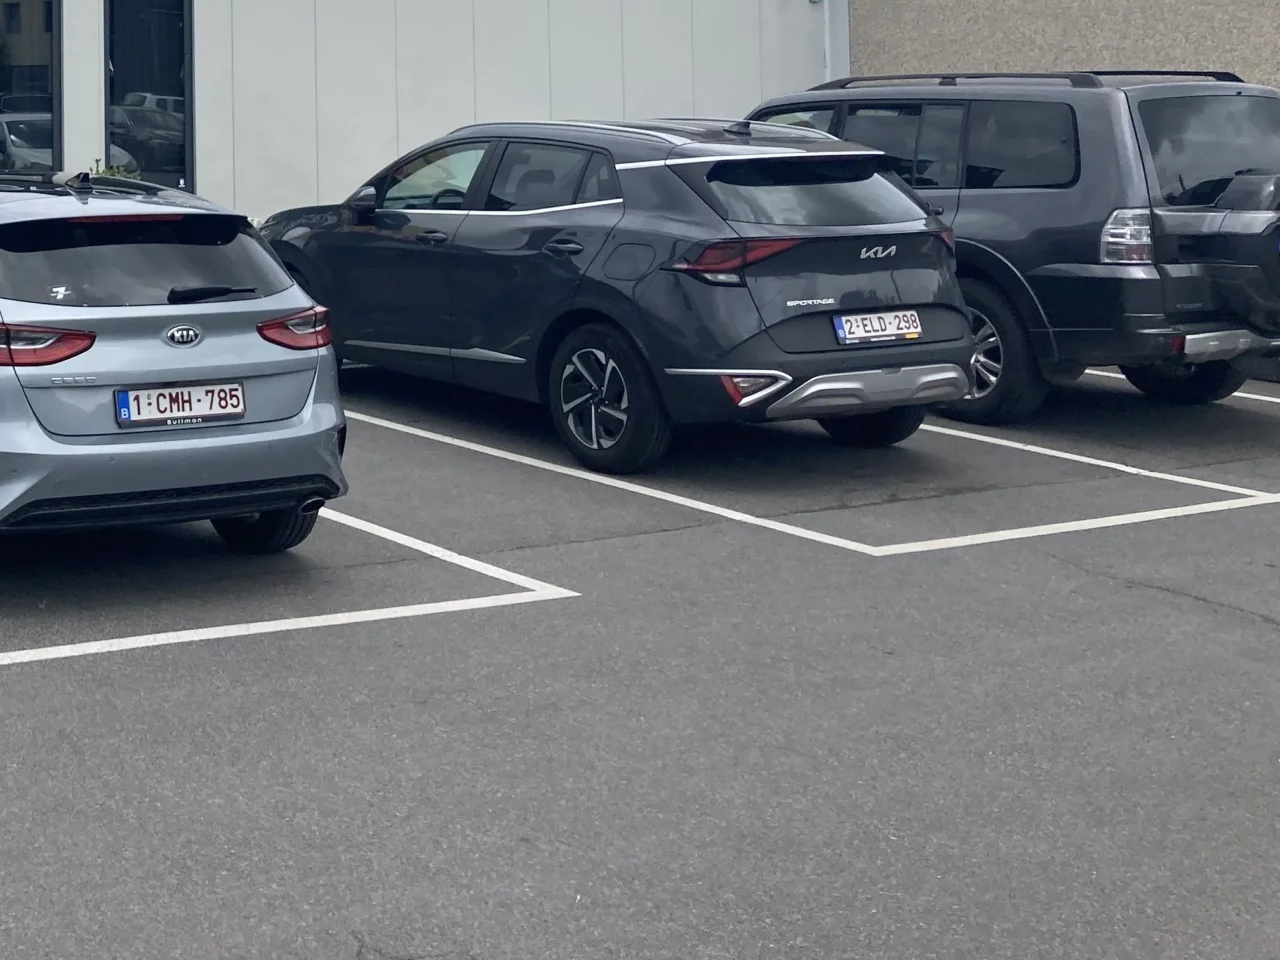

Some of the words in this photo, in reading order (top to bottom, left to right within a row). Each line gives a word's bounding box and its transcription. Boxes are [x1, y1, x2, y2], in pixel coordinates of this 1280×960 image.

[786, 297, 836, 307] SPORTAGE
[173, 330, 197, 343] KIA
[120, 407, 129, 419] B
[166, 417, 203, 425] Bullman
